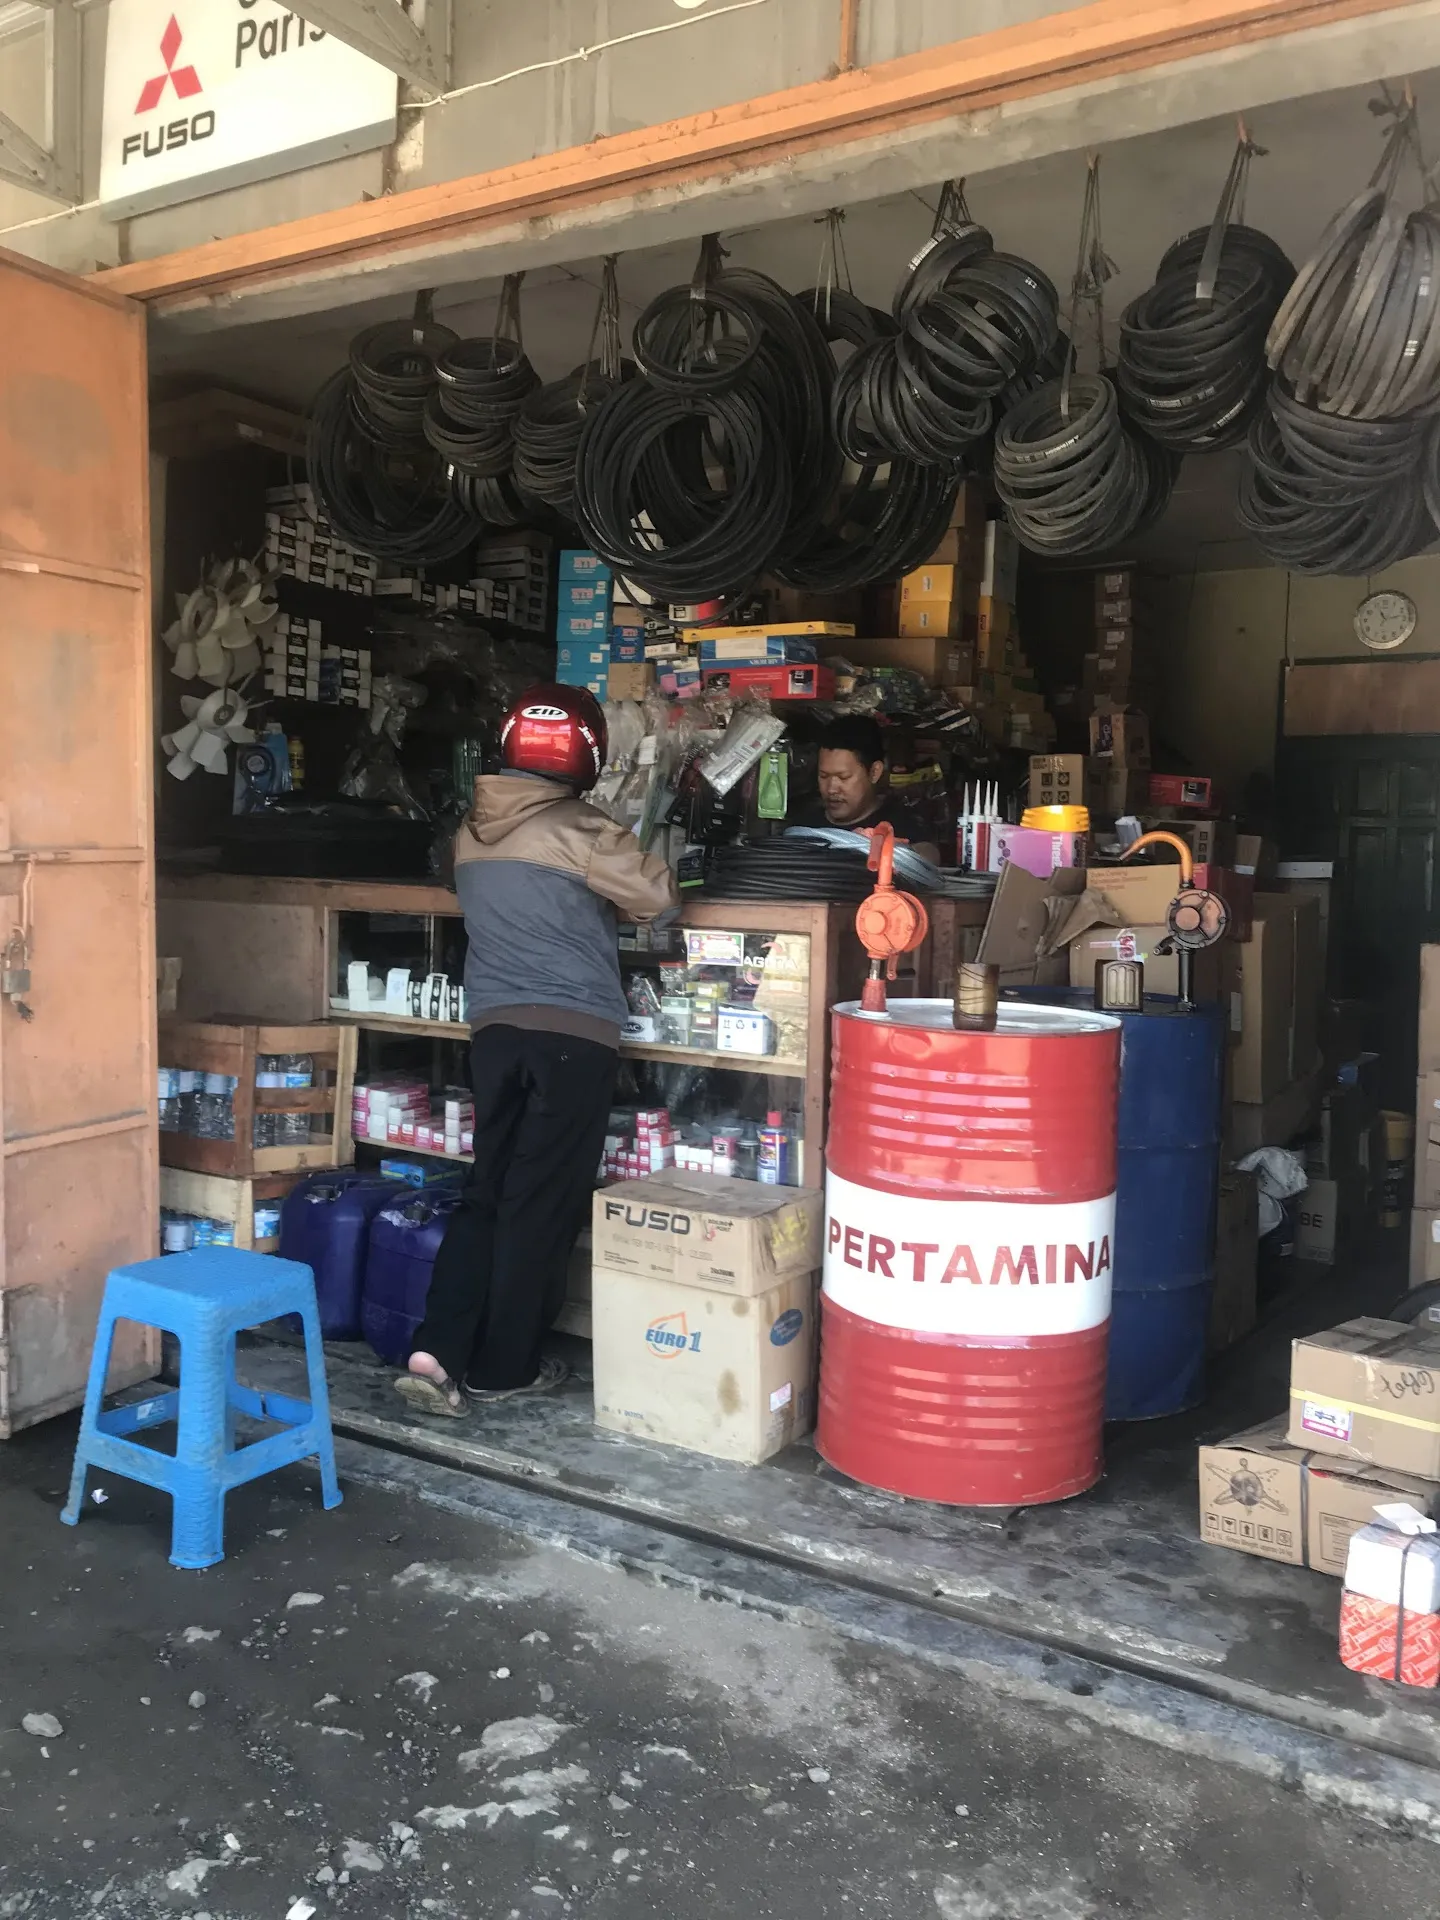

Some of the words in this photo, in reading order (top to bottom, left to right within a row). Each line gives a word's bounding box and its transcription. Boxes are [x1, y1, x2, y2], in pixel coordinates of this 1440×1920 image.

[122, 110, 215, 165] FUSO
[605, 1201, 690, 1235] FUSO
[828, 1215, 1111, 1285] PERTAMINA
[645, 1329, 687, 1349] EURO
[688, 1331, 702, 1353] 1
